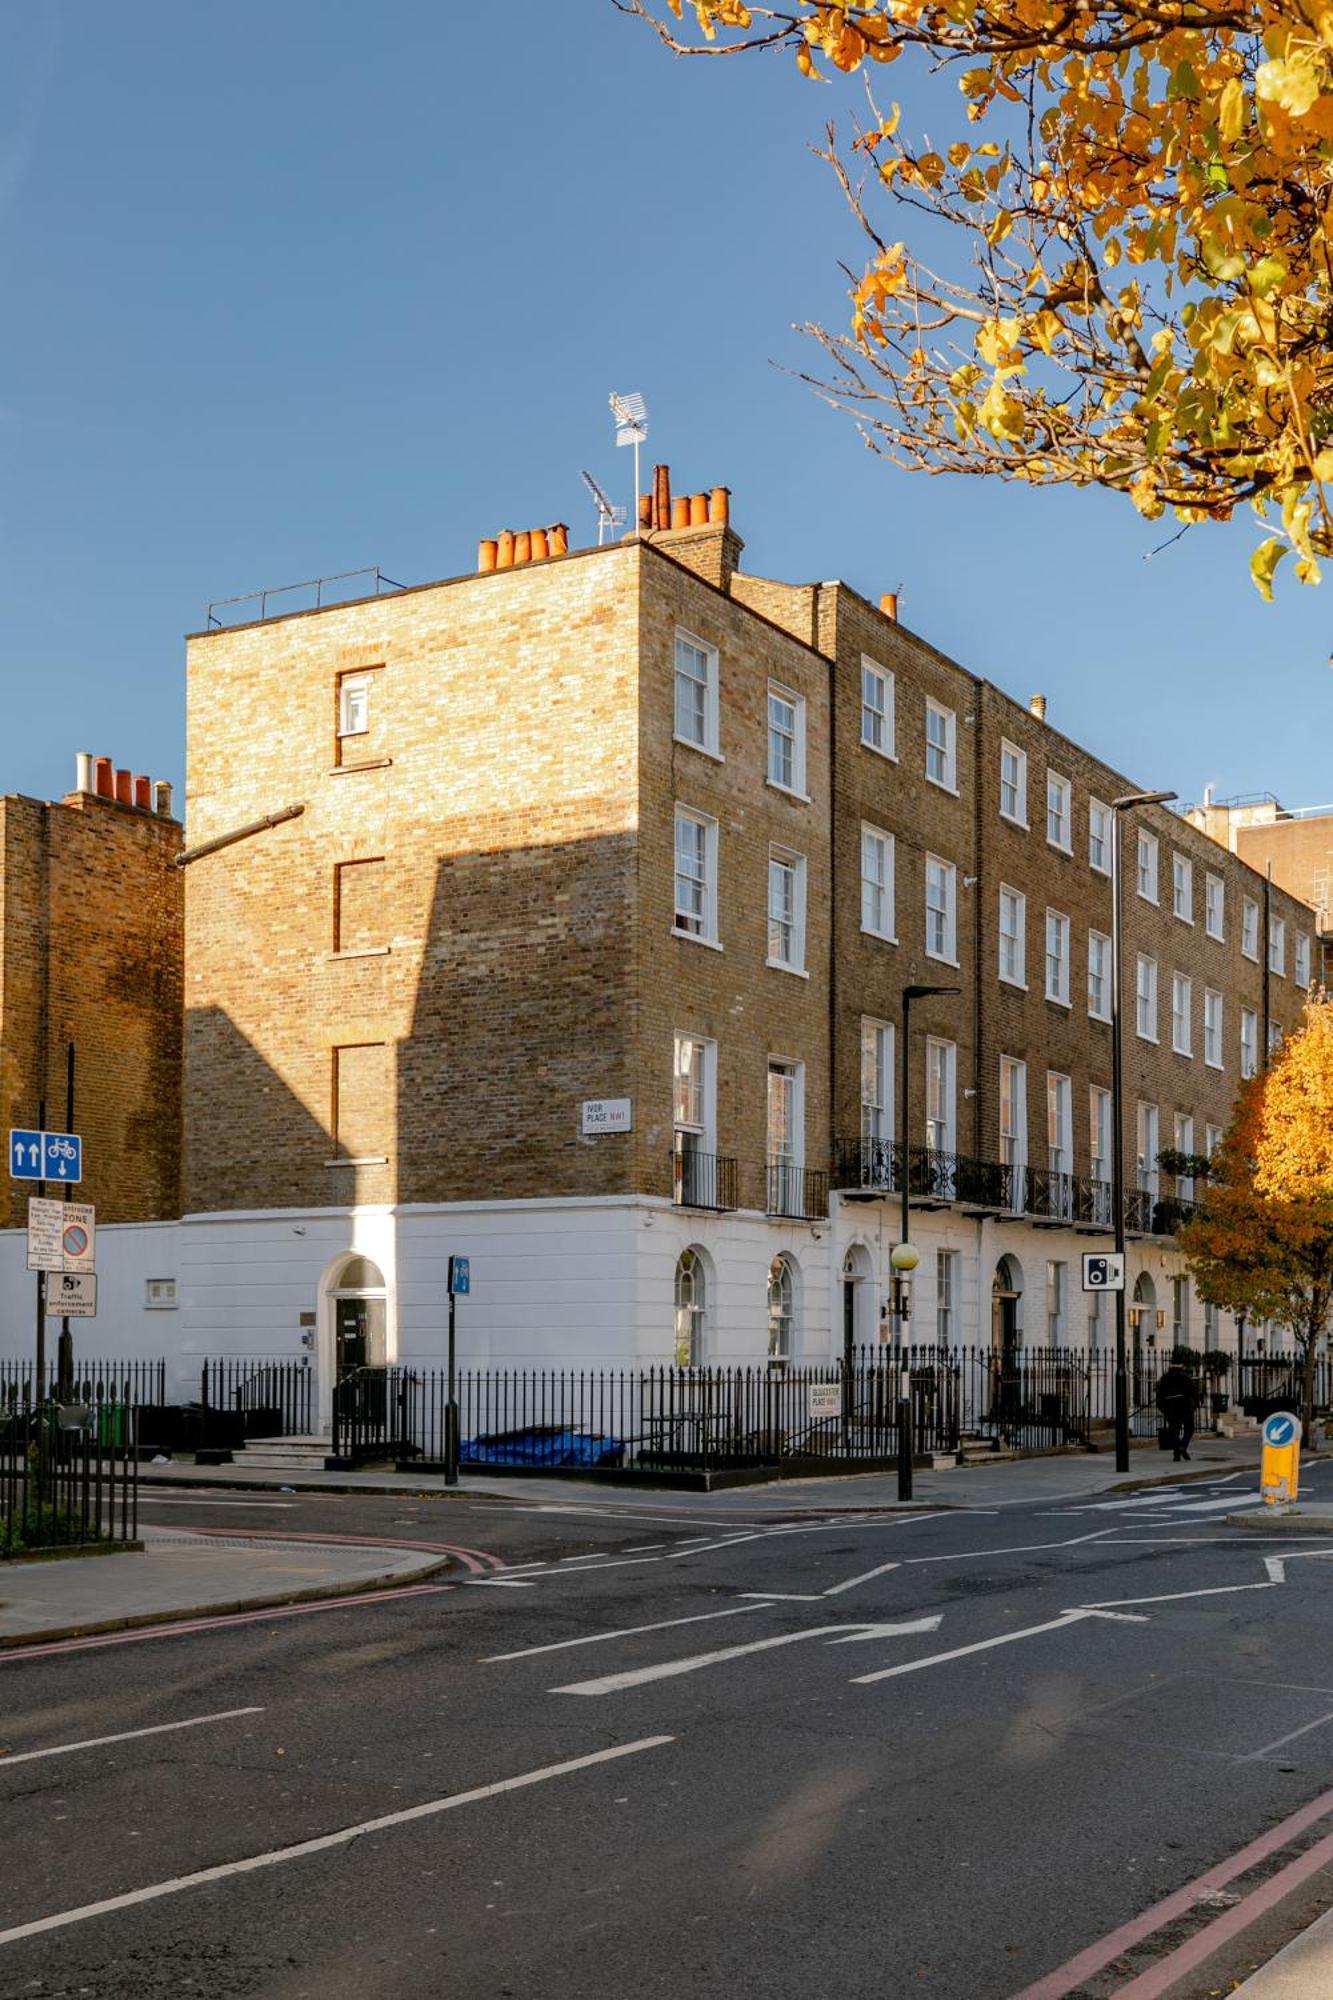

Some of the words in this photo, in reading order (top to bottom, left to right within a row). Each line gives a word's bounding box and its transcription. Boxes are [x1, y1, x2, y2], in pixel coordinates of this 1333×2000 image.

[586, 1103, 603, 1113] IVOR
[586, 1112, 608, 1122] PLACE
[610, 1111, 625, 1121] NW1
[63, 1205, 93, 1214] ontrolled
[63, 1214, 88, 1224] ZONE
